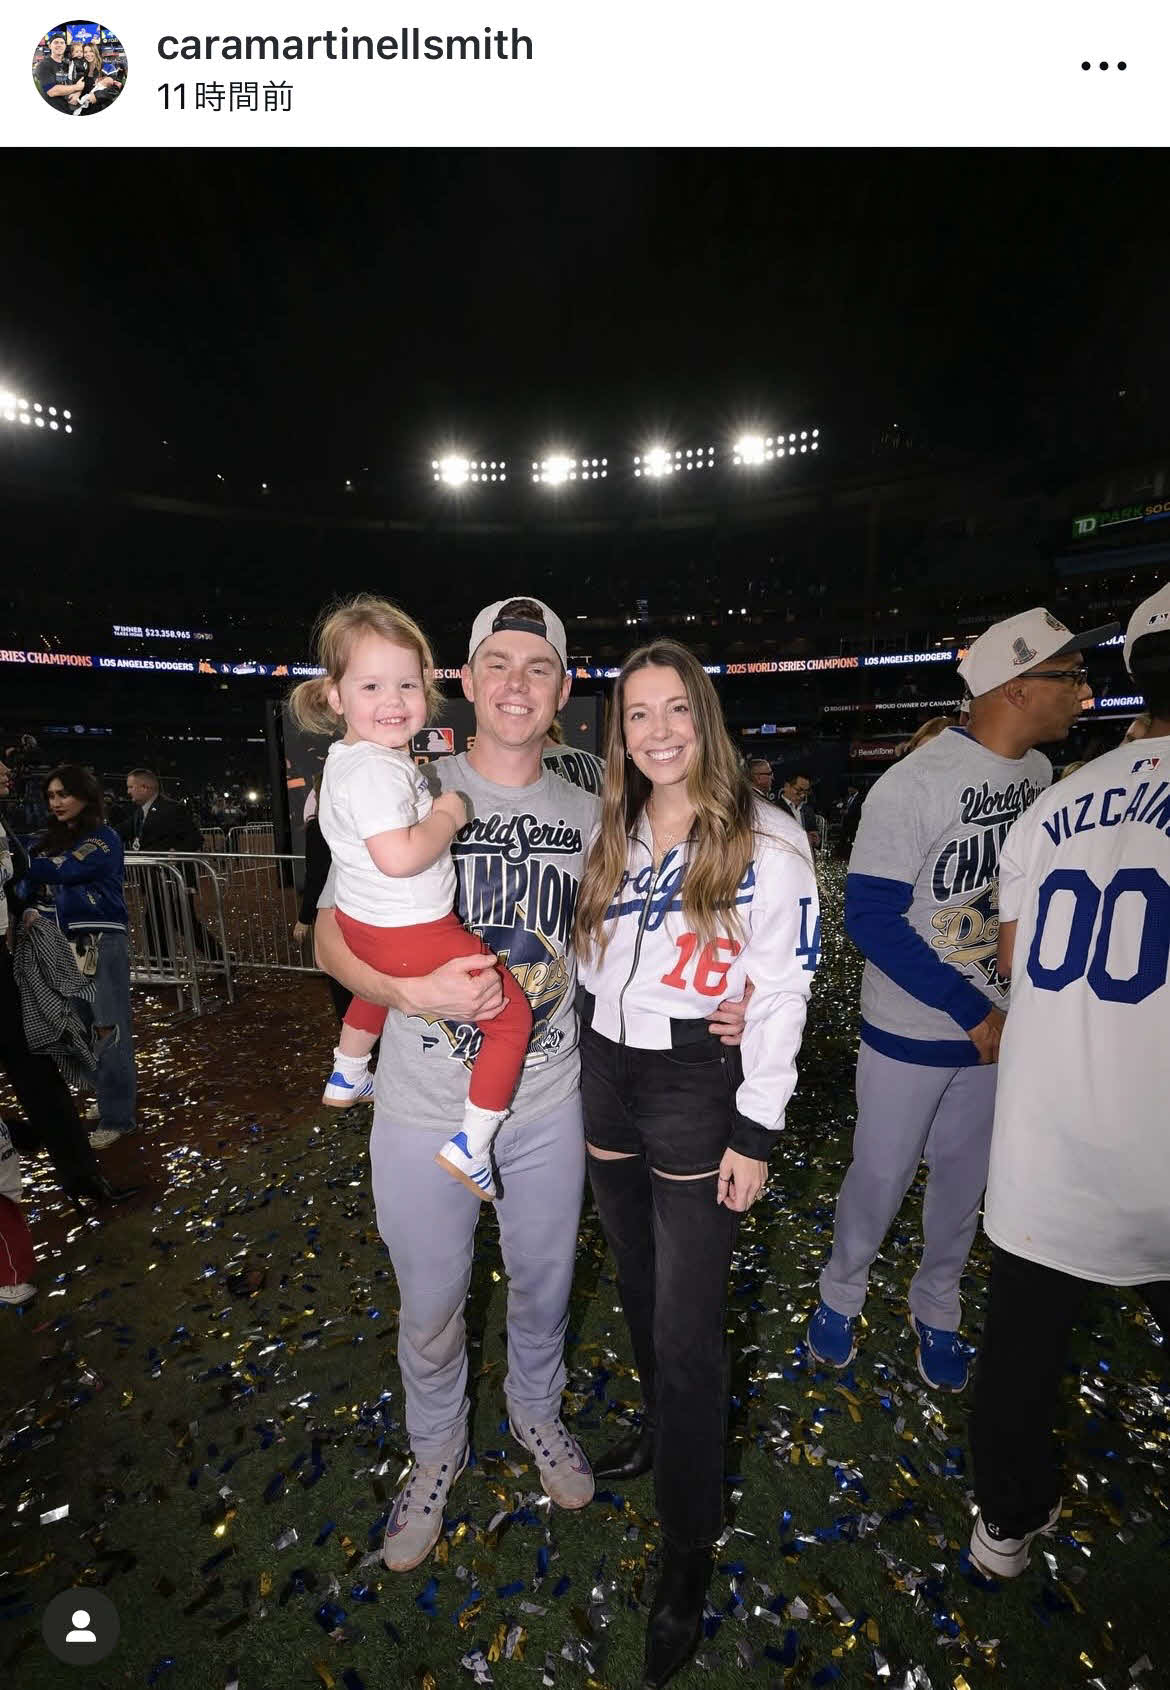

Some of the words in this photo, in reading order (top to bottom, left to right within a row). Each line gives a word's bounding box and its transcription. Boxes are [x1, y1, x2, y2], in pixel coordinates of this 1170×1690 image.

[1074, 517, 1097, 533] TD
[113, 625, 143, 633] WINNER
[0, 650, 26, 663] RIES
[27, 652, 93, 667] CHAMPIONS
[99, 658, 116, 667] LOS
[117, 660, 155, 669] ANGELES
[155, 662, 194, 671] DODGERS
[726, 663, 747, 675] 2025
[747, 662, 778, 674] WORLD
[778, 660, 806, 672] SERIES
[806, 657, 859, 671] CHAMPIONS
[864, 657, 879, 666] LOS
[879, 655, 913, 665] ANGELES
[914, 652, 952, 663] DODGERS
[960, 779, 1021, 824] World
[456, 812, 520, 845] orld
[501, 812, 583, 865] Series
[1027, 868, 1170, 1005] 00
[660, 932, 742, 997] 16
